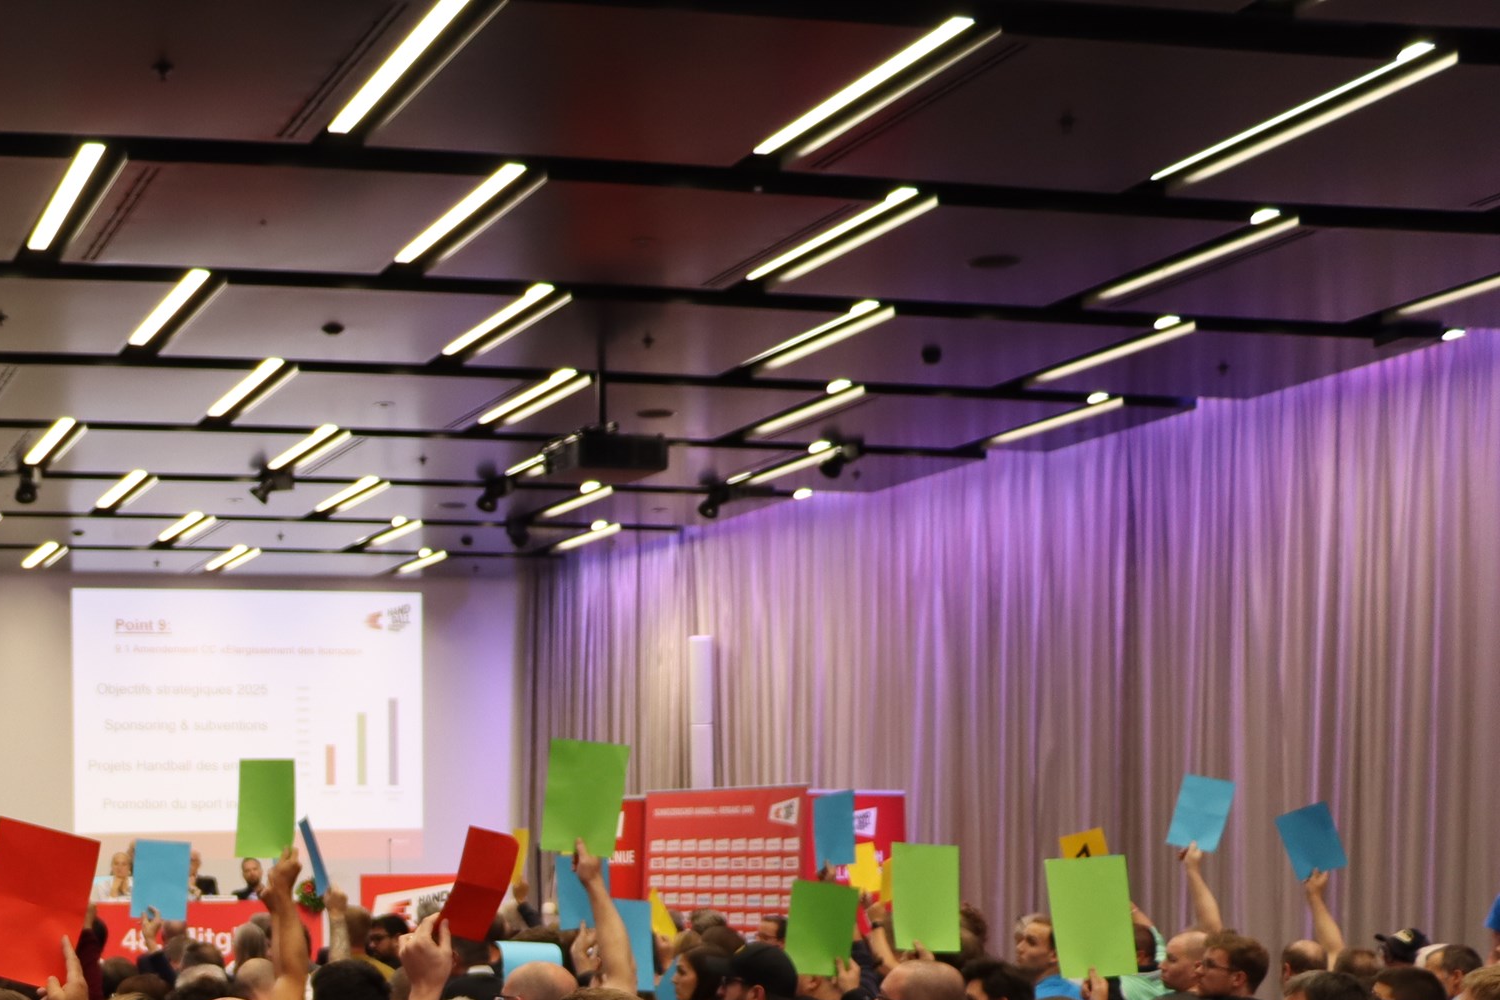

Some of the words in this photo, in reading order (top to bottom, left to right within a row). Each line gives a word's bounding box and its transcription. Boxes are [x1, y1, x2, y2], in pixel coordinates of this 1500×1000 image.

[115, 618, 153, 631] Point
[236, 683, 269, 696] 2025
[104, 718, 177, 733] Sponsoring
[179, 718, 188, 731] &
[193, 719, 268, 731] subventions
[88, 760, 133, 773] Projets
[136, 760, 192, 771] Handball
[195, 760, 219, 771] des
[222, 761, 239, 771] en
[102, 798, 168, 809] Promotion
[171, 798, 187, 809] du
[190, 798, 223, 811] sport
